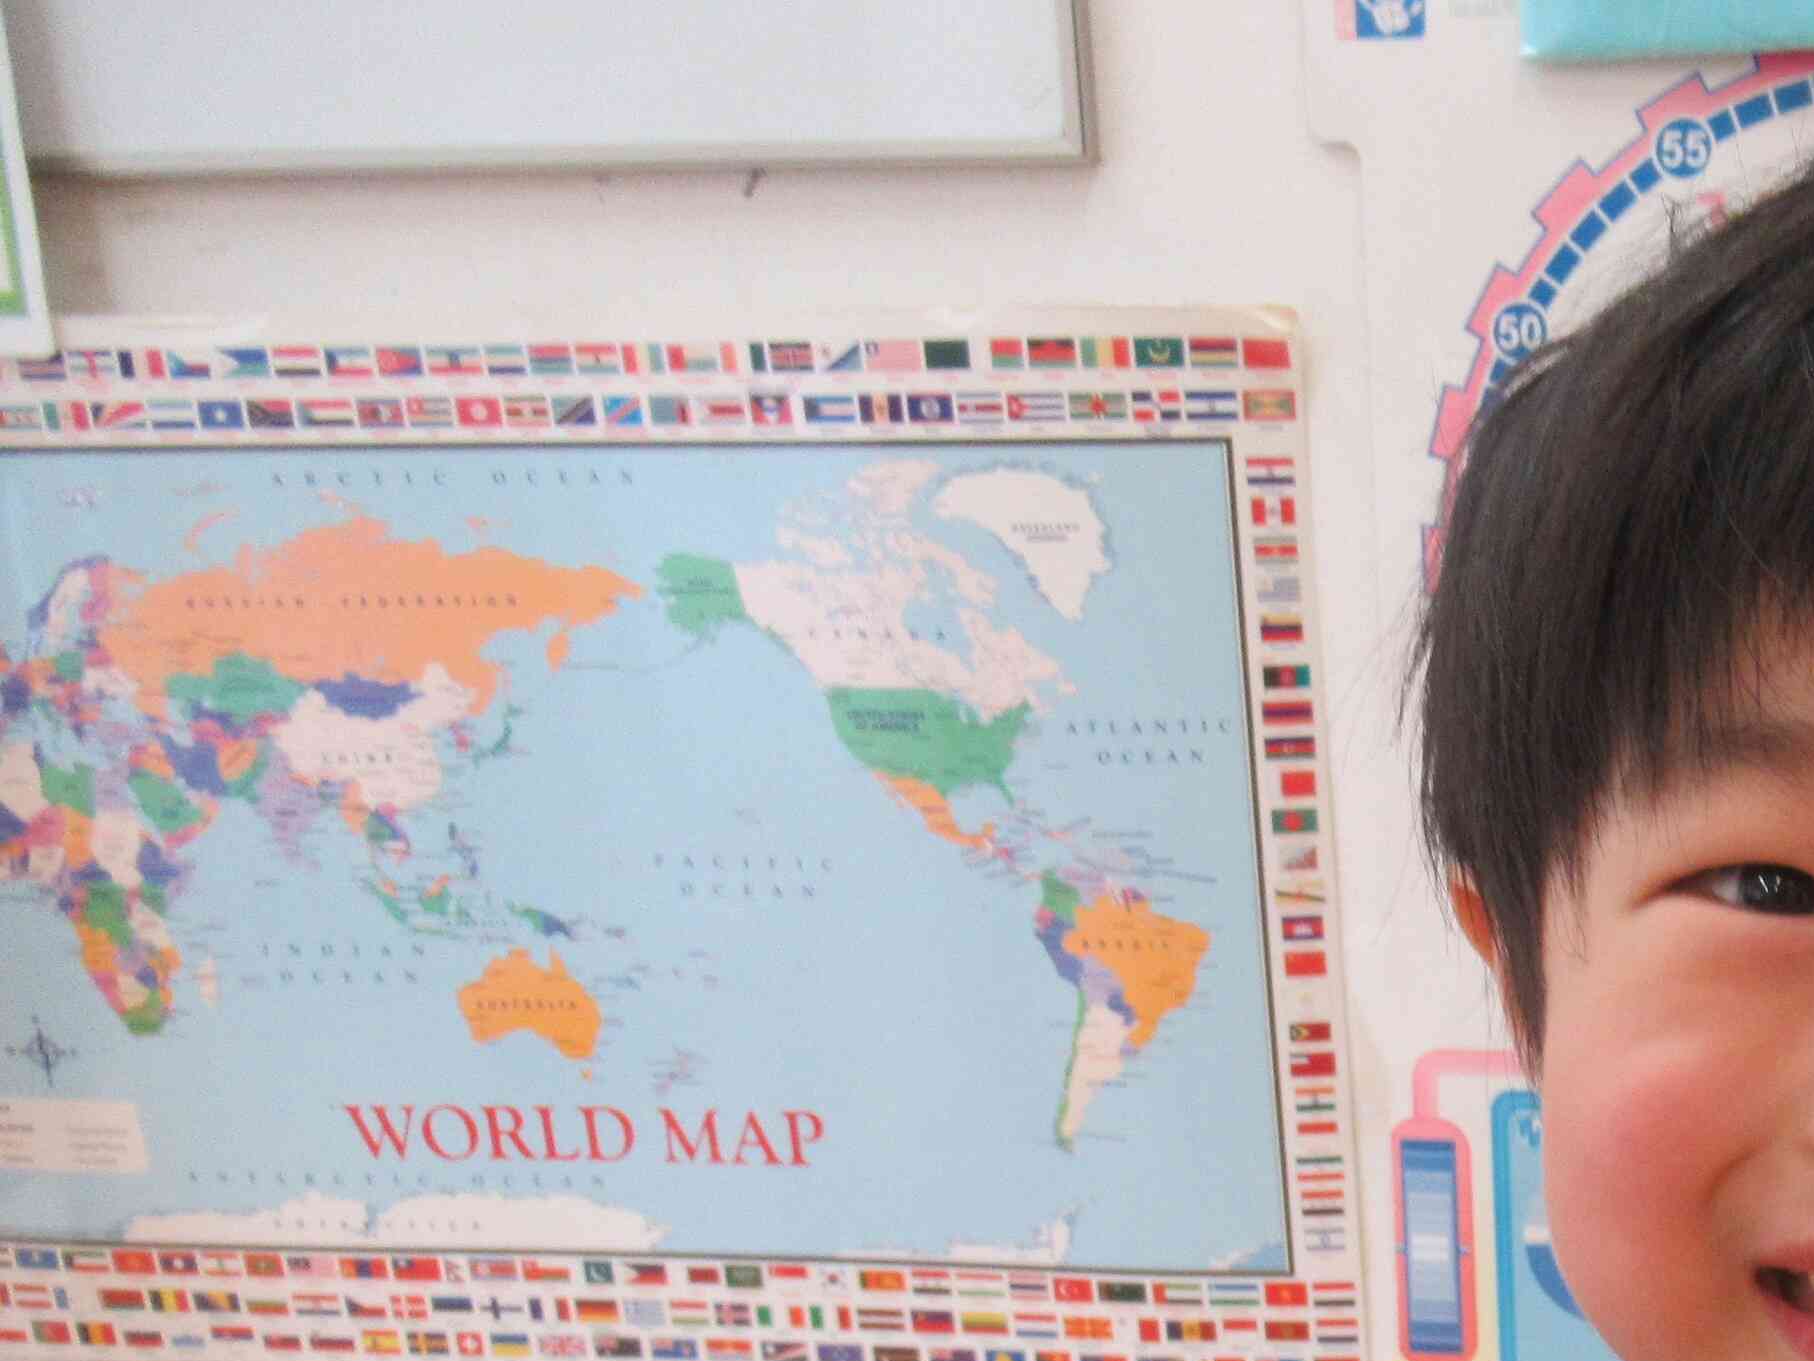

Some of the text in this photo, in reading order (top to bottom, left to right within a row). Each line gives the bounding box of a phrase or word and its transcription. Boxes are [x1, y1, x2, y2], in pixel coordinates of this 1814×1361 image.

[1660, 129, 1710, 169] 55
[1499, 313, 1541, 352] 50
[272, 468, 633, 486] ARCTIC OCEAN
[1065, 719, 1232, 736] ATLANTIC
[1097, 750, 1204, 766] OCEAN
[654, 852, 832, 873] PACIFIC
[679, 879, 817, 899] OCEAN
[258, 942, 425, 959] INDIAN
[279, 969, 418, 985] OCEAN
[345, 1103, 825, 1167] WORLD MAP
